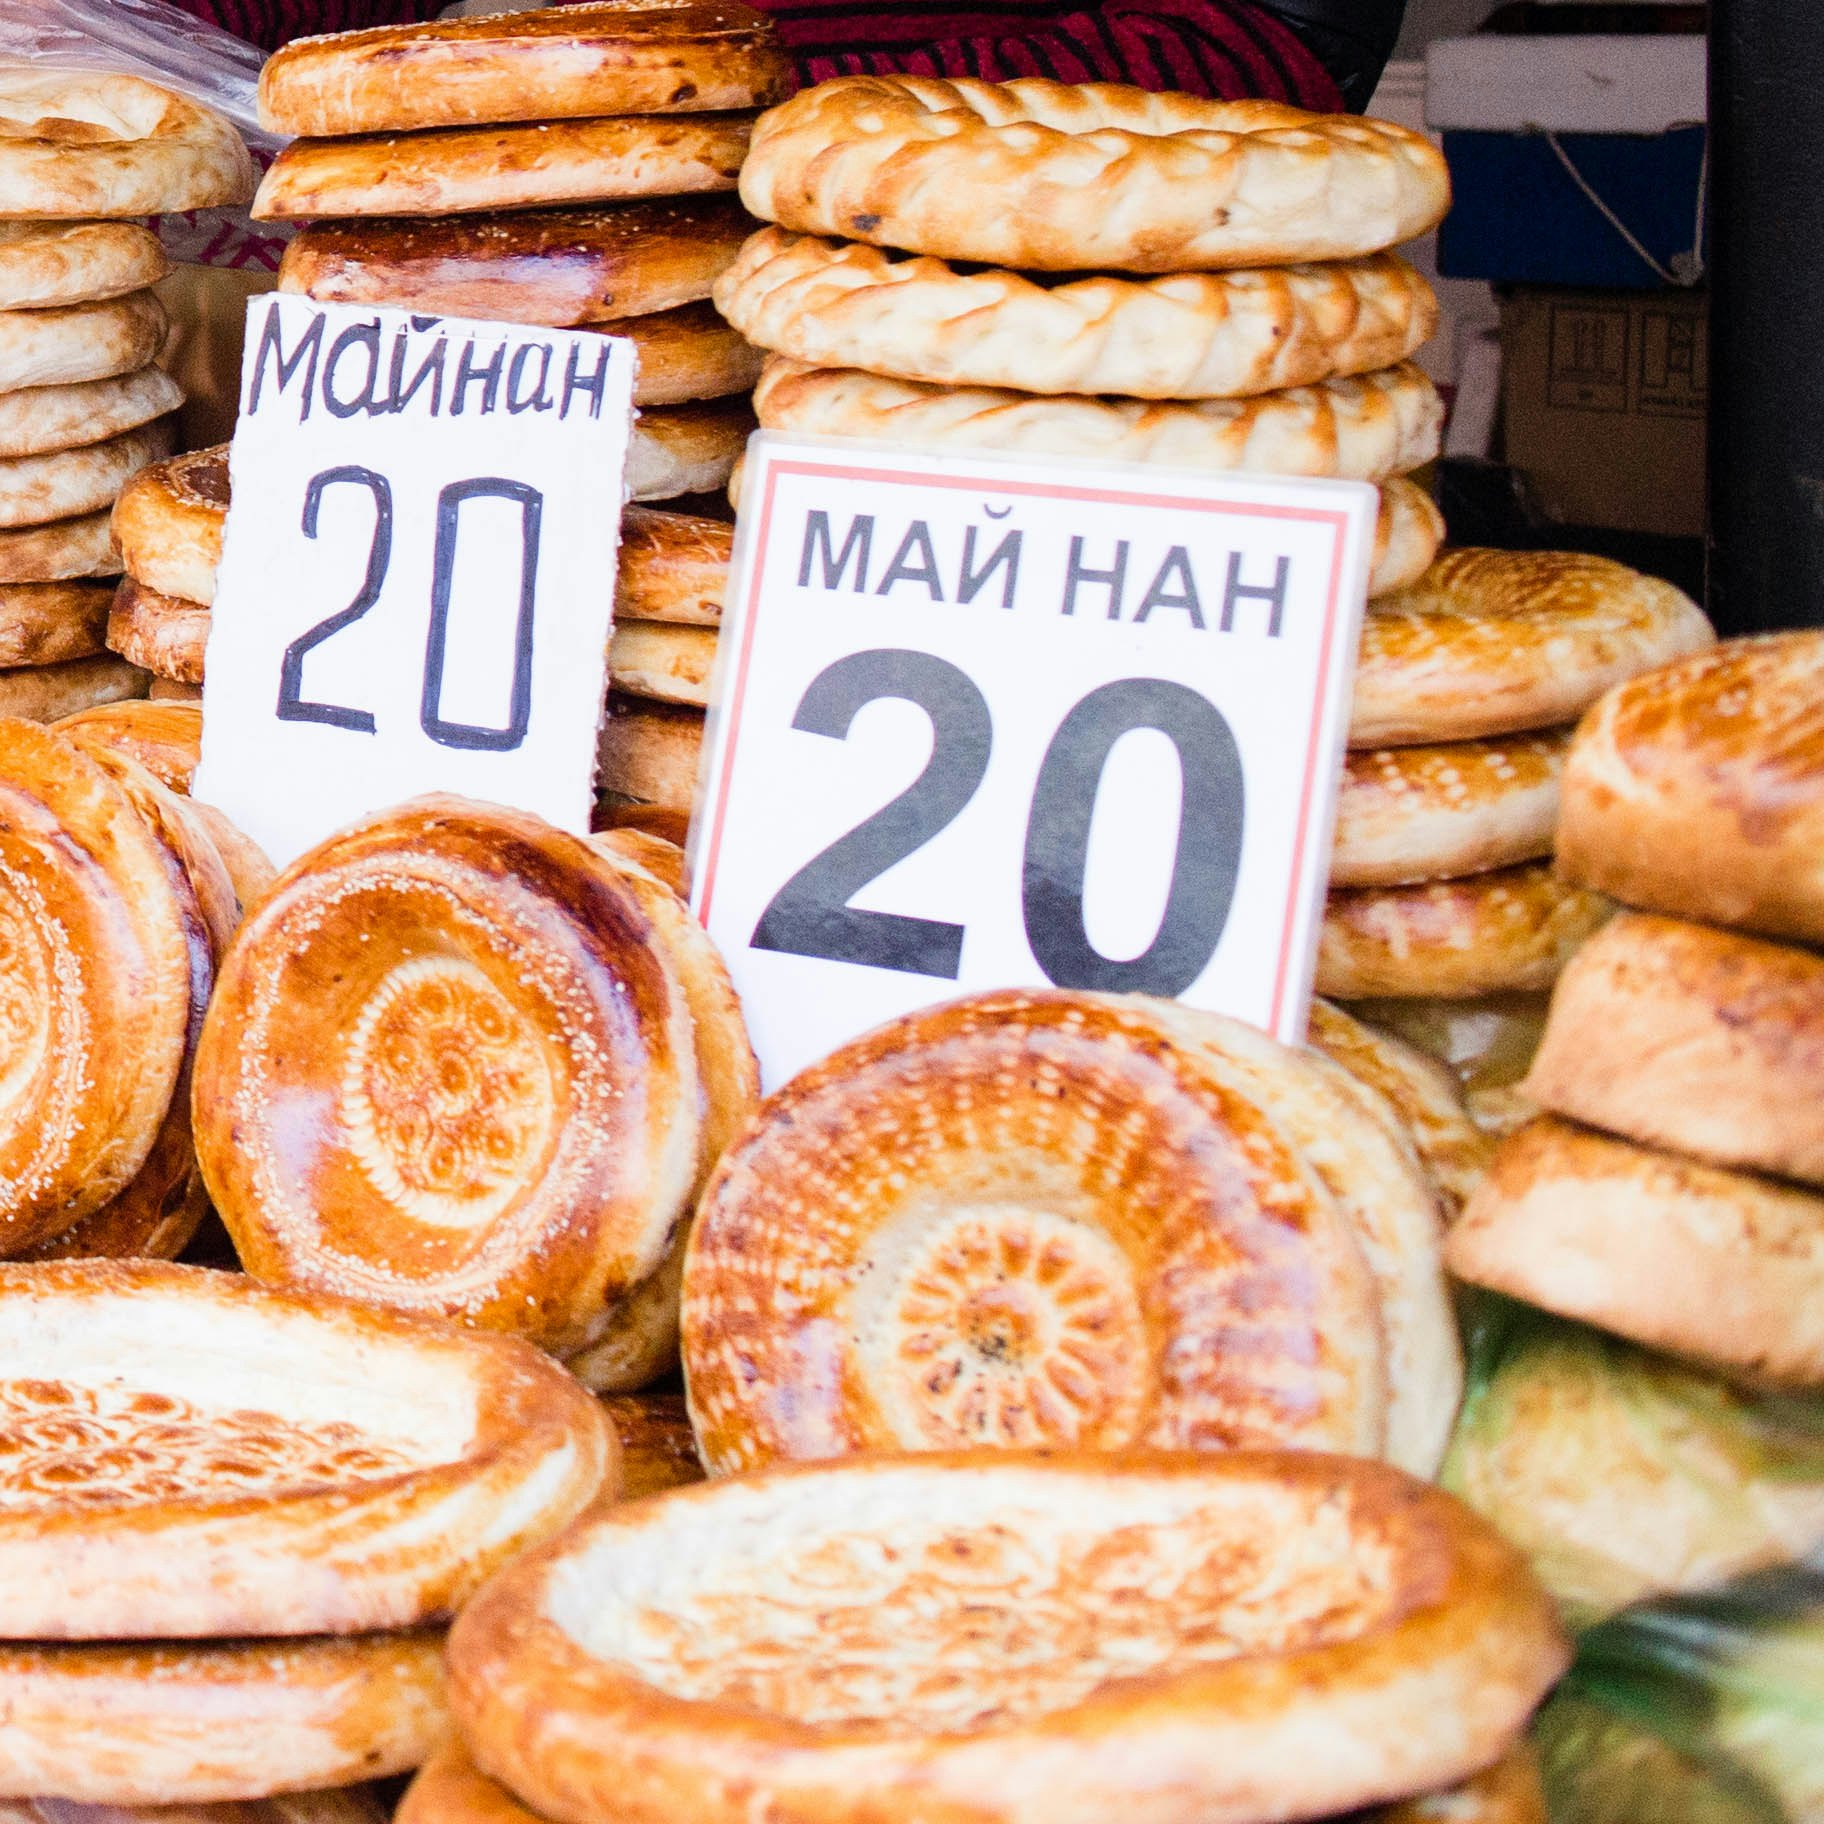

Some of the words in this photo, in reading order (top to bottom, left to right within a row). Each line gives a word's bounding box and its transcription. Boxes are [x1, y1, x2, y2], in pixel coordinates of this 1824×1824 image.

[275, 465, 543, 752] 20
[798, 503, 1022, 610] МАЙ
[1061, 534, 1290, 639] НАН
[749, 647, 1246, 998] 20
